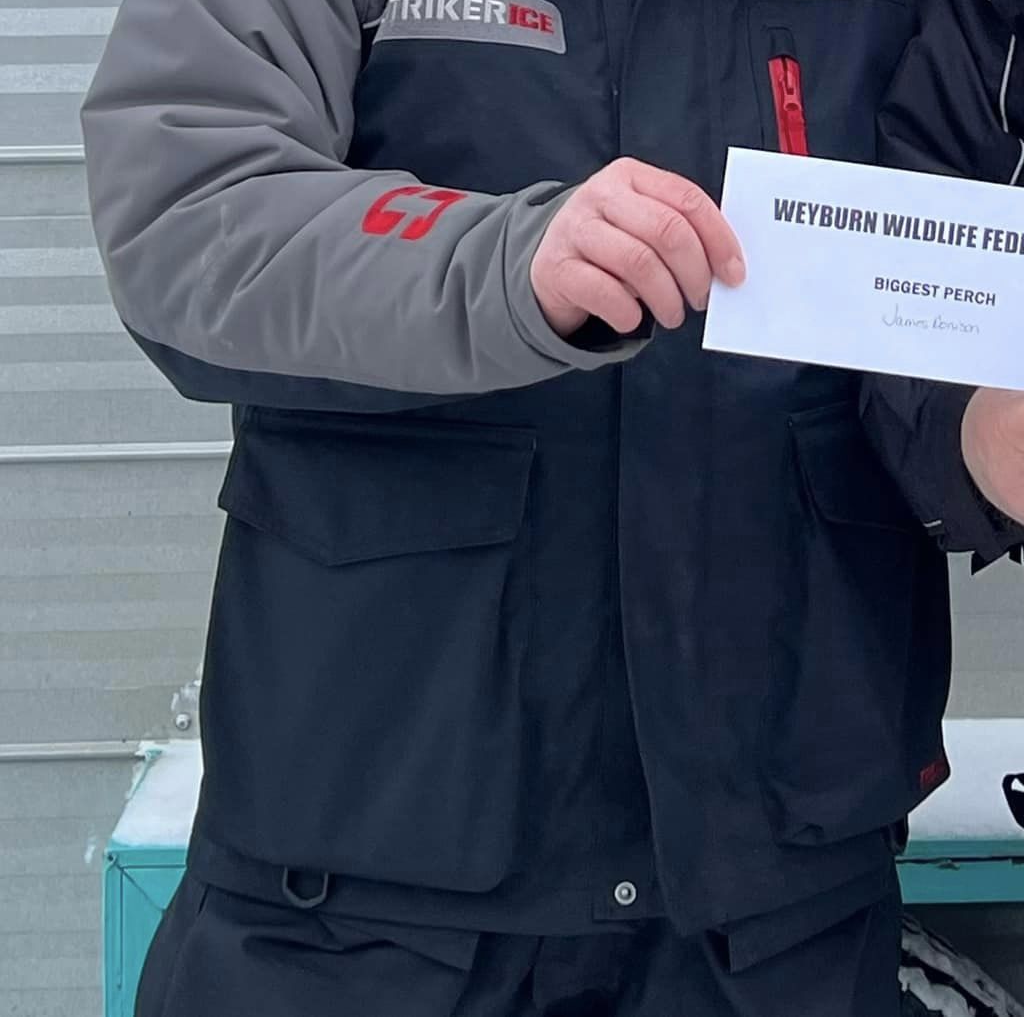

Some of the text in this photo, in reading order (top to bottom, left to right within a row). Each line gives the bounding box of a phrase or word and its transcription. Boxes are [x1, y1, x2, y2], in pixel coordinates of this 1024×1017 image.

[774, 198, 877, 233] WEYBURN
[882, 212, 978, 249] WILDLIFE
[875, 277, 996, 306] BIGGEST PERCH
[882, 303, 928, 329] James
